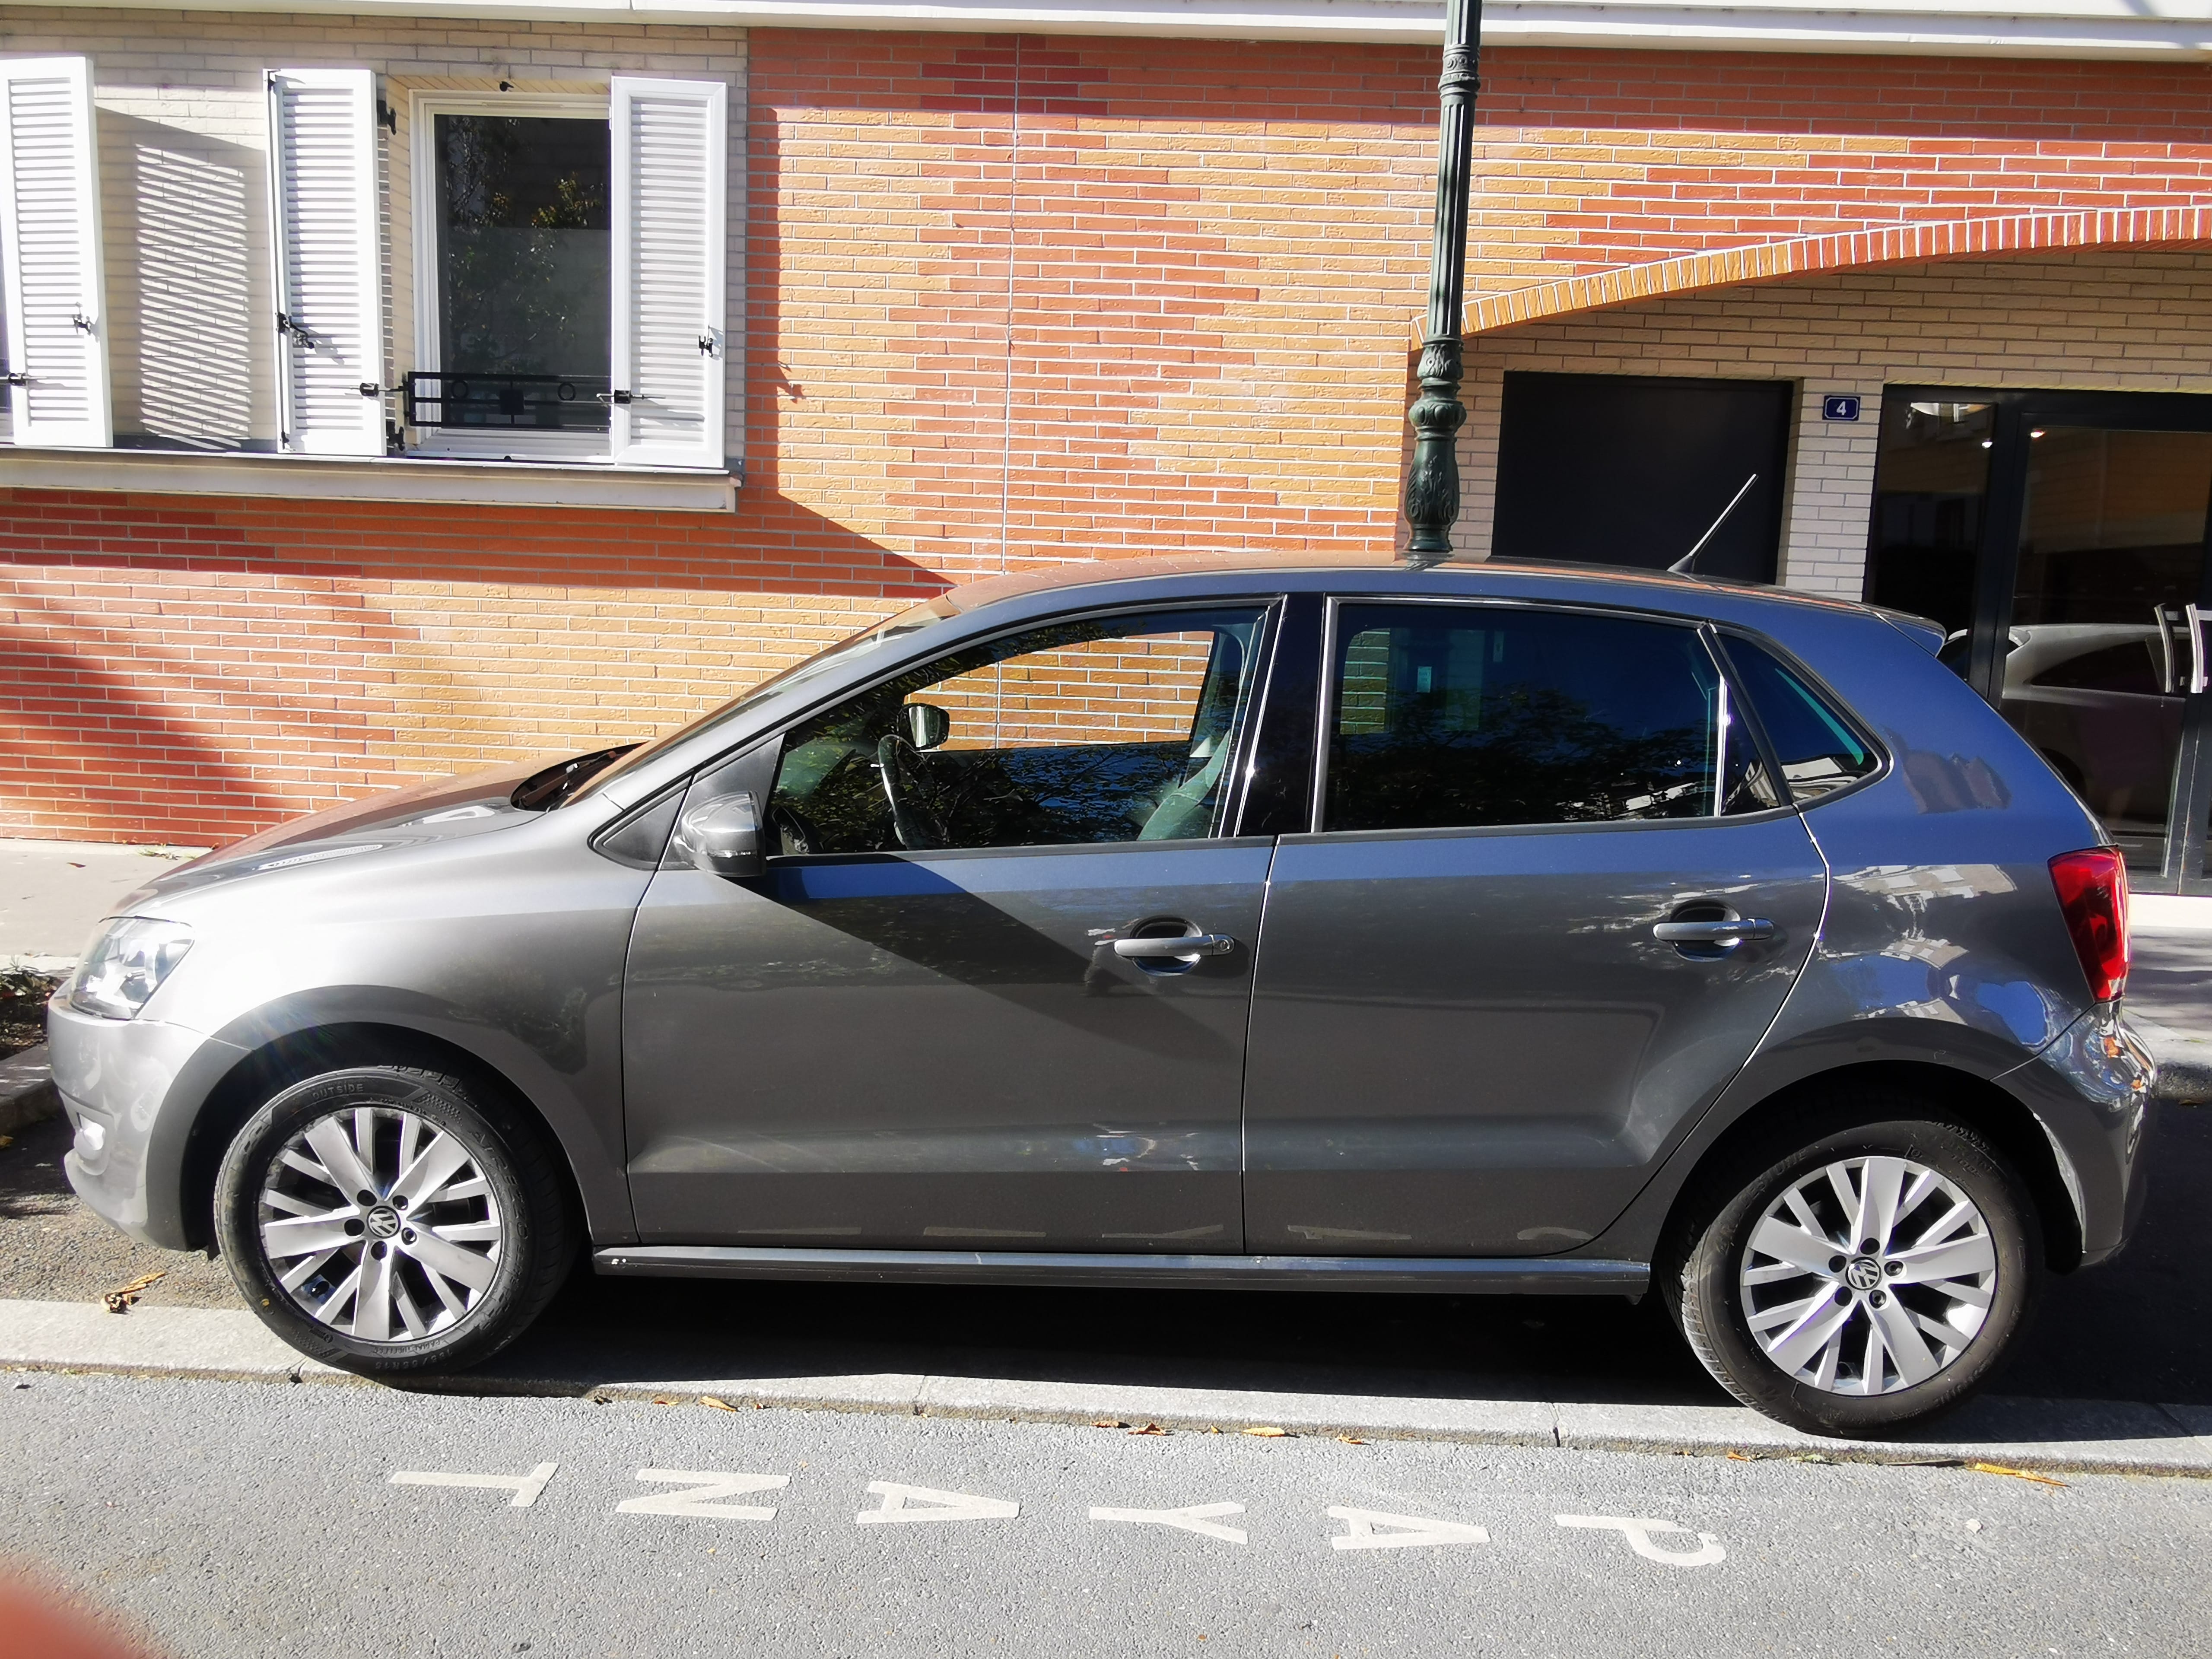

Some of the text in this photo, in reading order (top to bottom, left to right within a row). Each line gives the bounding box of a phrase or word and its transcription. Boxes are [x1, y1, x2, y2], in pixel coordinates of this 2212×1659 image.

[1836, 401, 1847, 416] 4
[312, 1084, 363, 1099] OUTSIDE
[388, 1462, 1727, 1567] PAYANT
